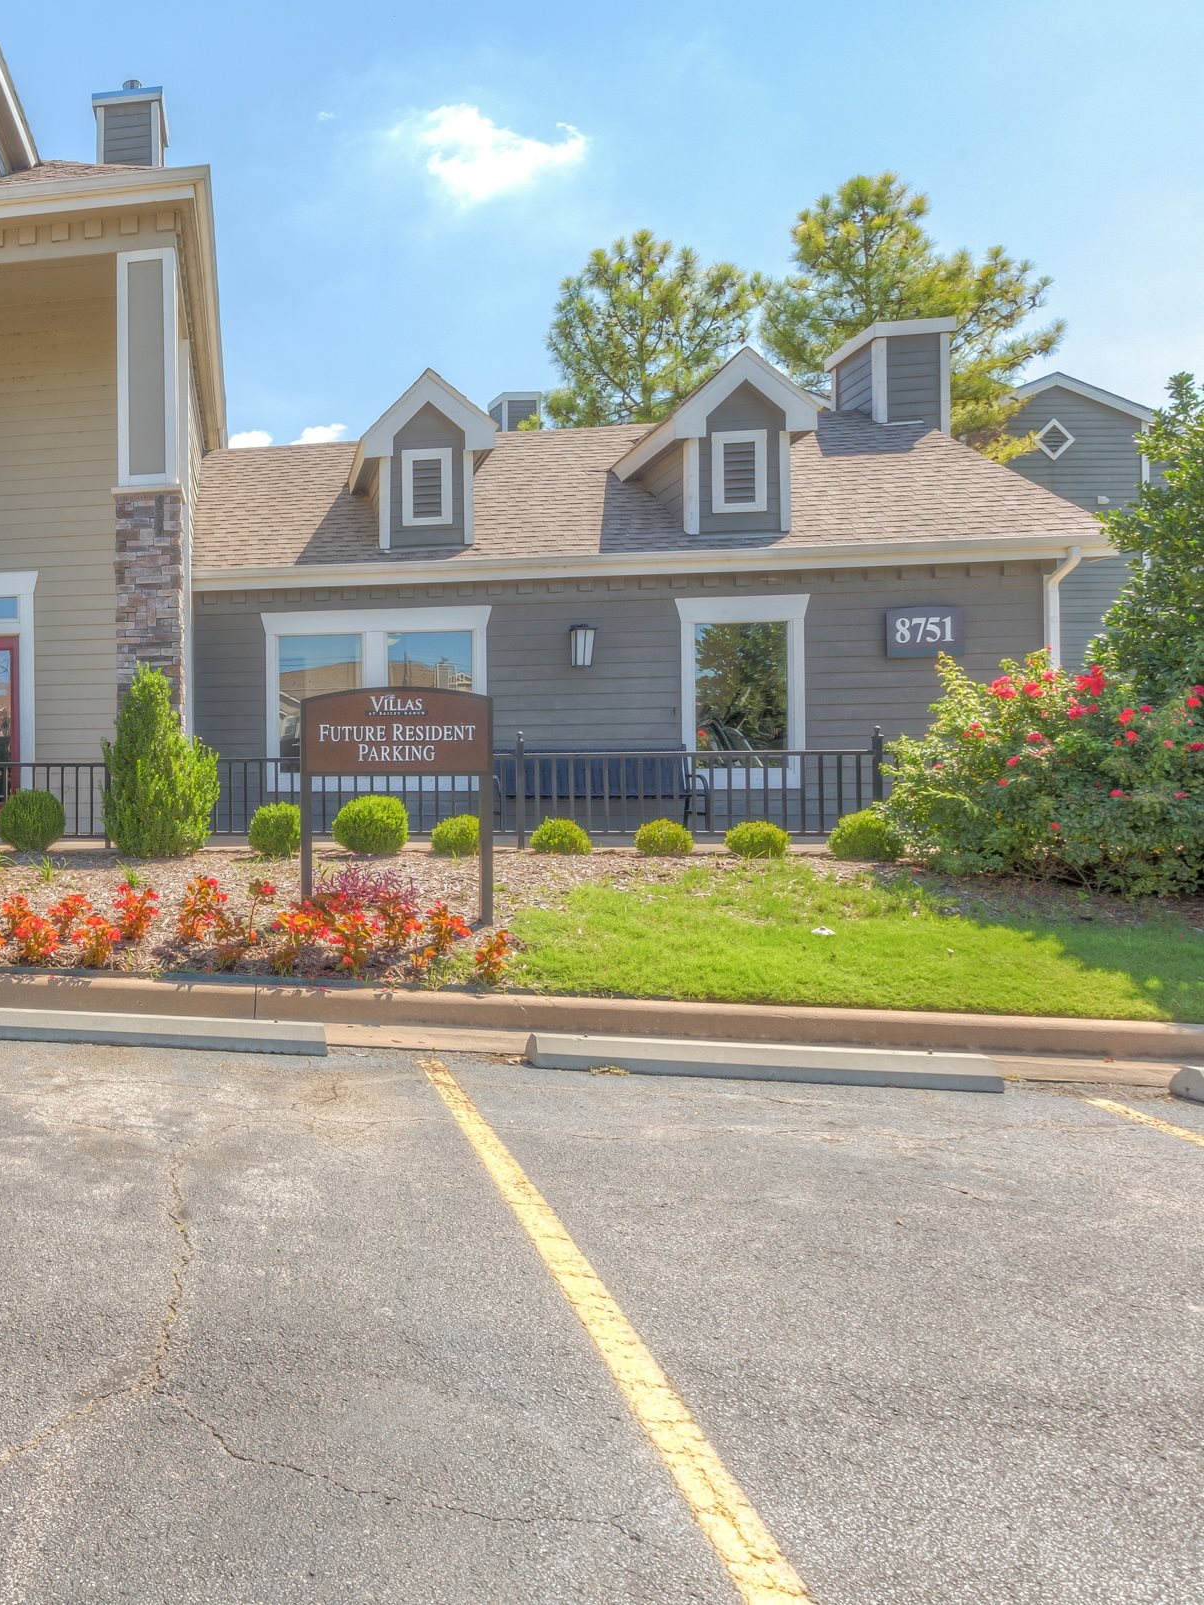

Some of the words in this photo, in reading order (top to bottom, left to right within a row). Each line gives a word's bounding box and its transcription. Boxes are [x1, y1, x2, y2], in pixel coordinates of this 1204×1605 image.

[895, 616, 955, 644] 8751
[369, 695, 423, 712] VILLAS
[318, 724, 387, 742] FUTURE
[392, 723, 476, 741] RESIDENT
[357, 743, 436, 762] PARKING
